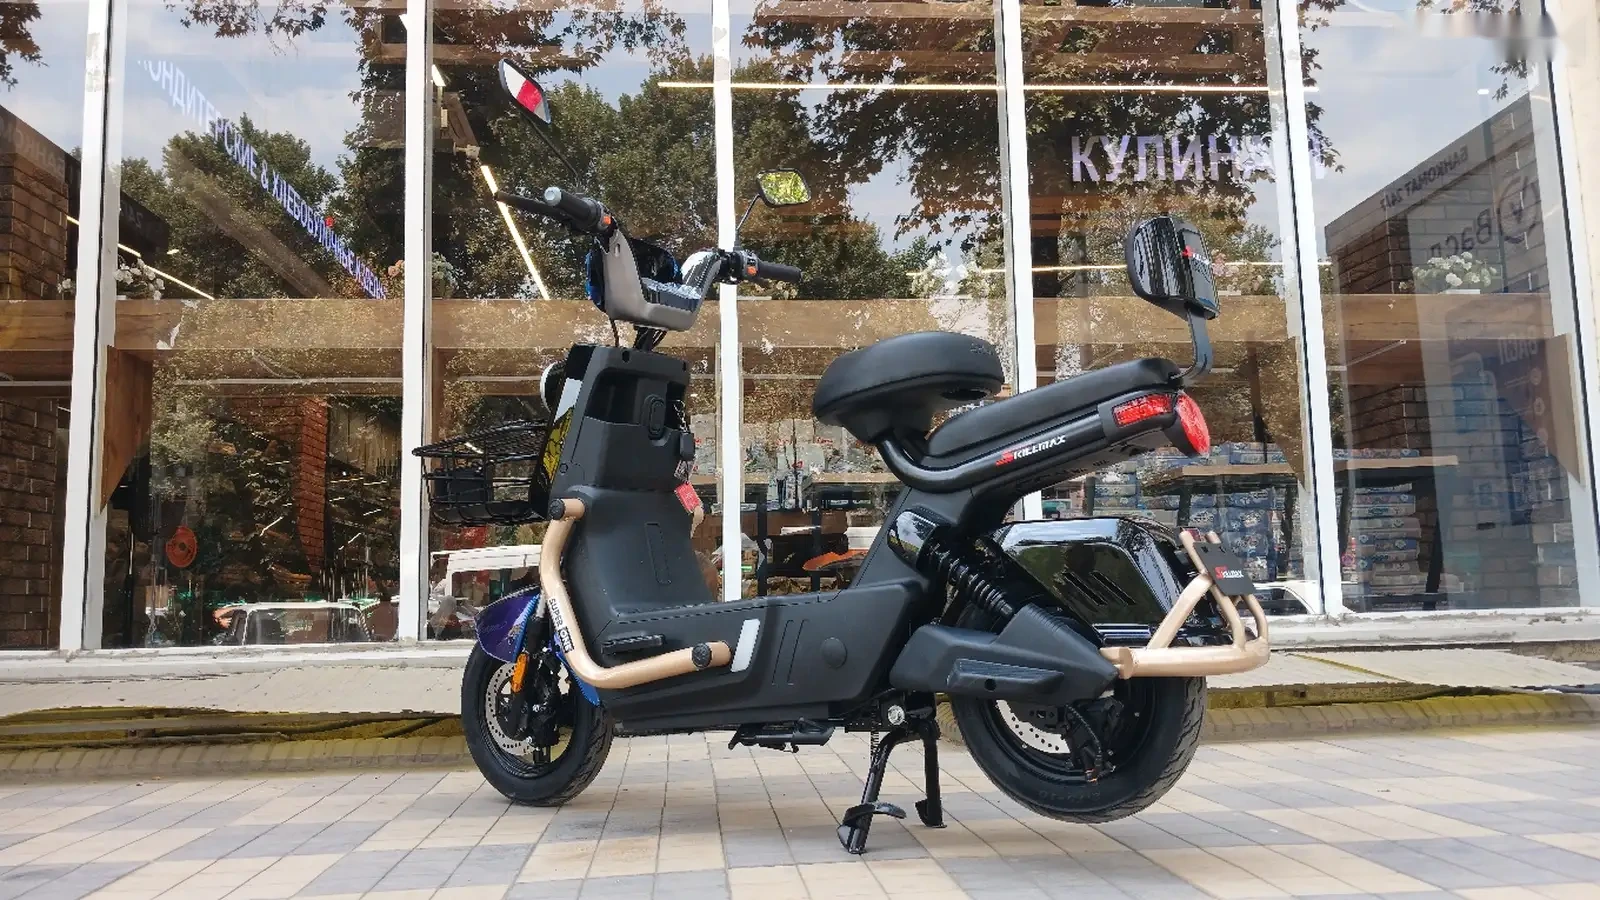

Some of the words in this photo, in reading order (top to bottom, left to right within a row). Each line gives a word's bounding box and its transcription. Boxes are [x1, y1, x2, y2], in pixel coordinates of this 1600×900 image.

[138, 60, 258, 179] ОНДИТЕРСКИЕ
[548, 598, 564, 628] SUPER
[559, 627, 575, 653] ONE
